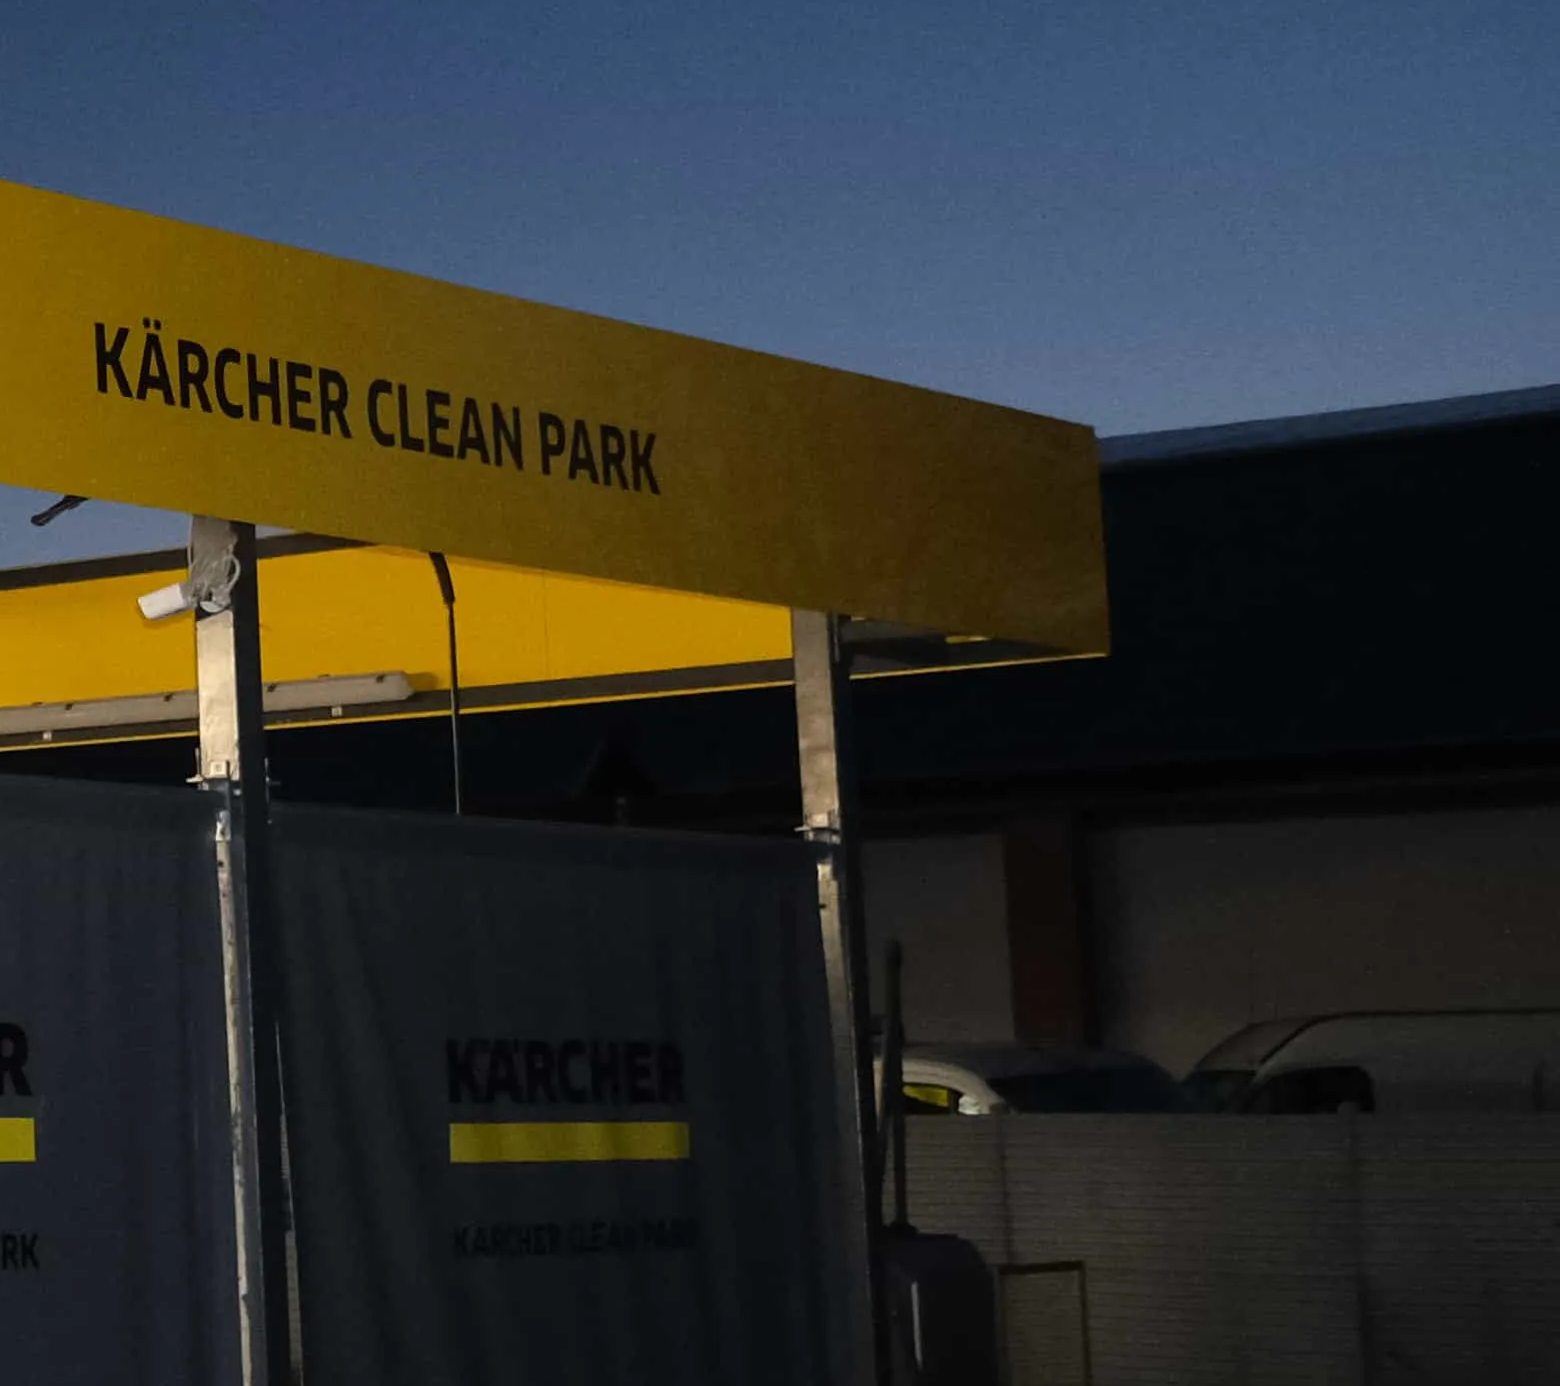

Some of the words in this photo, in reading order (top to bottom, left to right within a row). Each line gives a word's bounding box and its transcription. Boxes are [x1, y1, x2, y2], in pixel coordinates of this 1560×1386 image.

[94, 317, 352, 439] KÄRCHER
[367, 379, 524, 471] CLEAN
[538, 411, 661, 495] PARK
[445, 1038, 687, 1104] KÄRCHER
